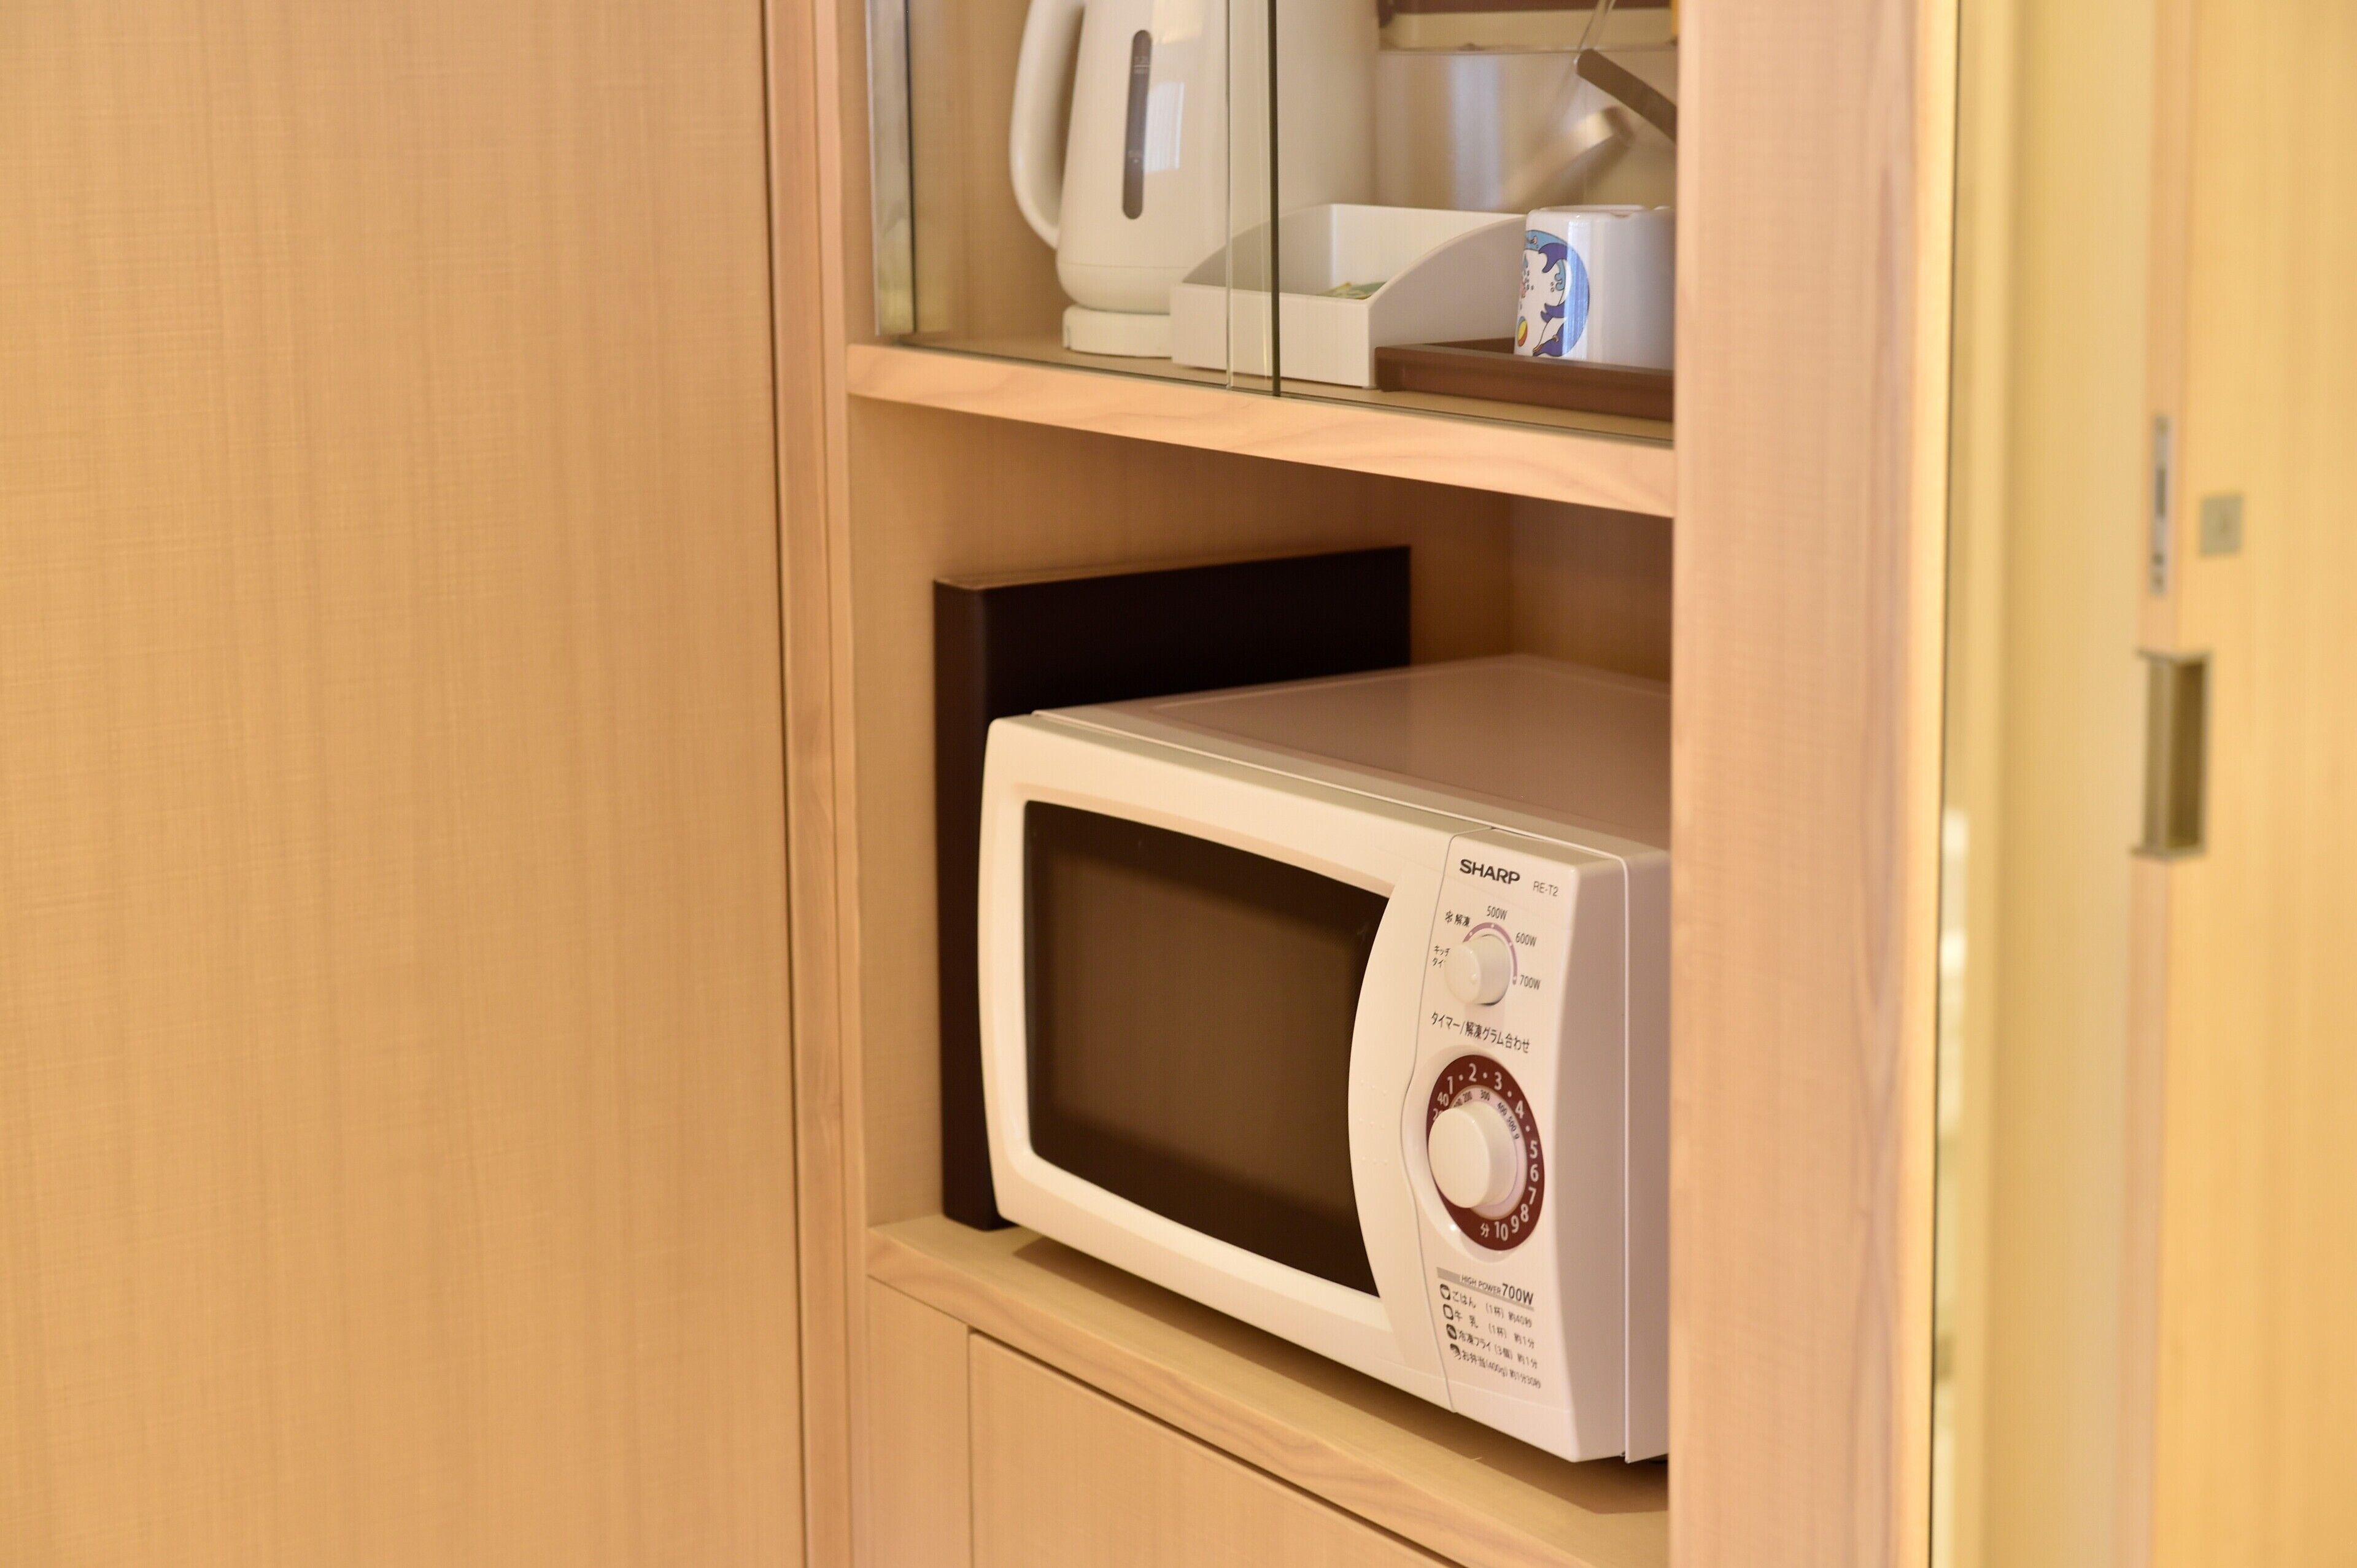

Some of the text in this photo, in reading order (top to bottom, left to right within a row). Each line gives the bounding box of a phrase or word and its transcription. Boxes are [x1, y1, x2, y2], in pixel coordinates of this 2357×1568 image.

[1460, 859, 1520, 884] SHARP
[1533, 881, 1558, 897] RE-T2
[1487, 906, 1507, 920] 500W
[1515, 932, 1536, 947] 600W
[1433, 957, 1446, 968] タイ
[1520, 975, 1541, 989] 700W
[1431, 1011, 1530, 1053] タイマー/解凍グラム合わせ
[1469, 1063, 1477, 1082] 2
[1494, 1072, 1503, 1091] 3
[1447, 1076, 1453, 1095] 1
[1437, 1092, 1449, 1106] 40
[1480, 1089, 1490, 1101] 300
[1497, 1102, 1507, 1116] 400
[1507, 1116, 1517, 1132] 500
[1515, 1100, 1524, 1119] 4
[1530, 1140, 1538, 1159] 5
[1530, 1164, 1539, 1182] 6
[1528, 1186, 1536, 1205] 7
[1520, 1203, 1529, 1222] 8
[1480, 1222, 1490, 1238] 分
[1494, 1221, 1509, 1241] 10
[1511, 1215, 1519, 1234] 9
[1461, 1275, 1533, 1305] HIGH POWER 700W
